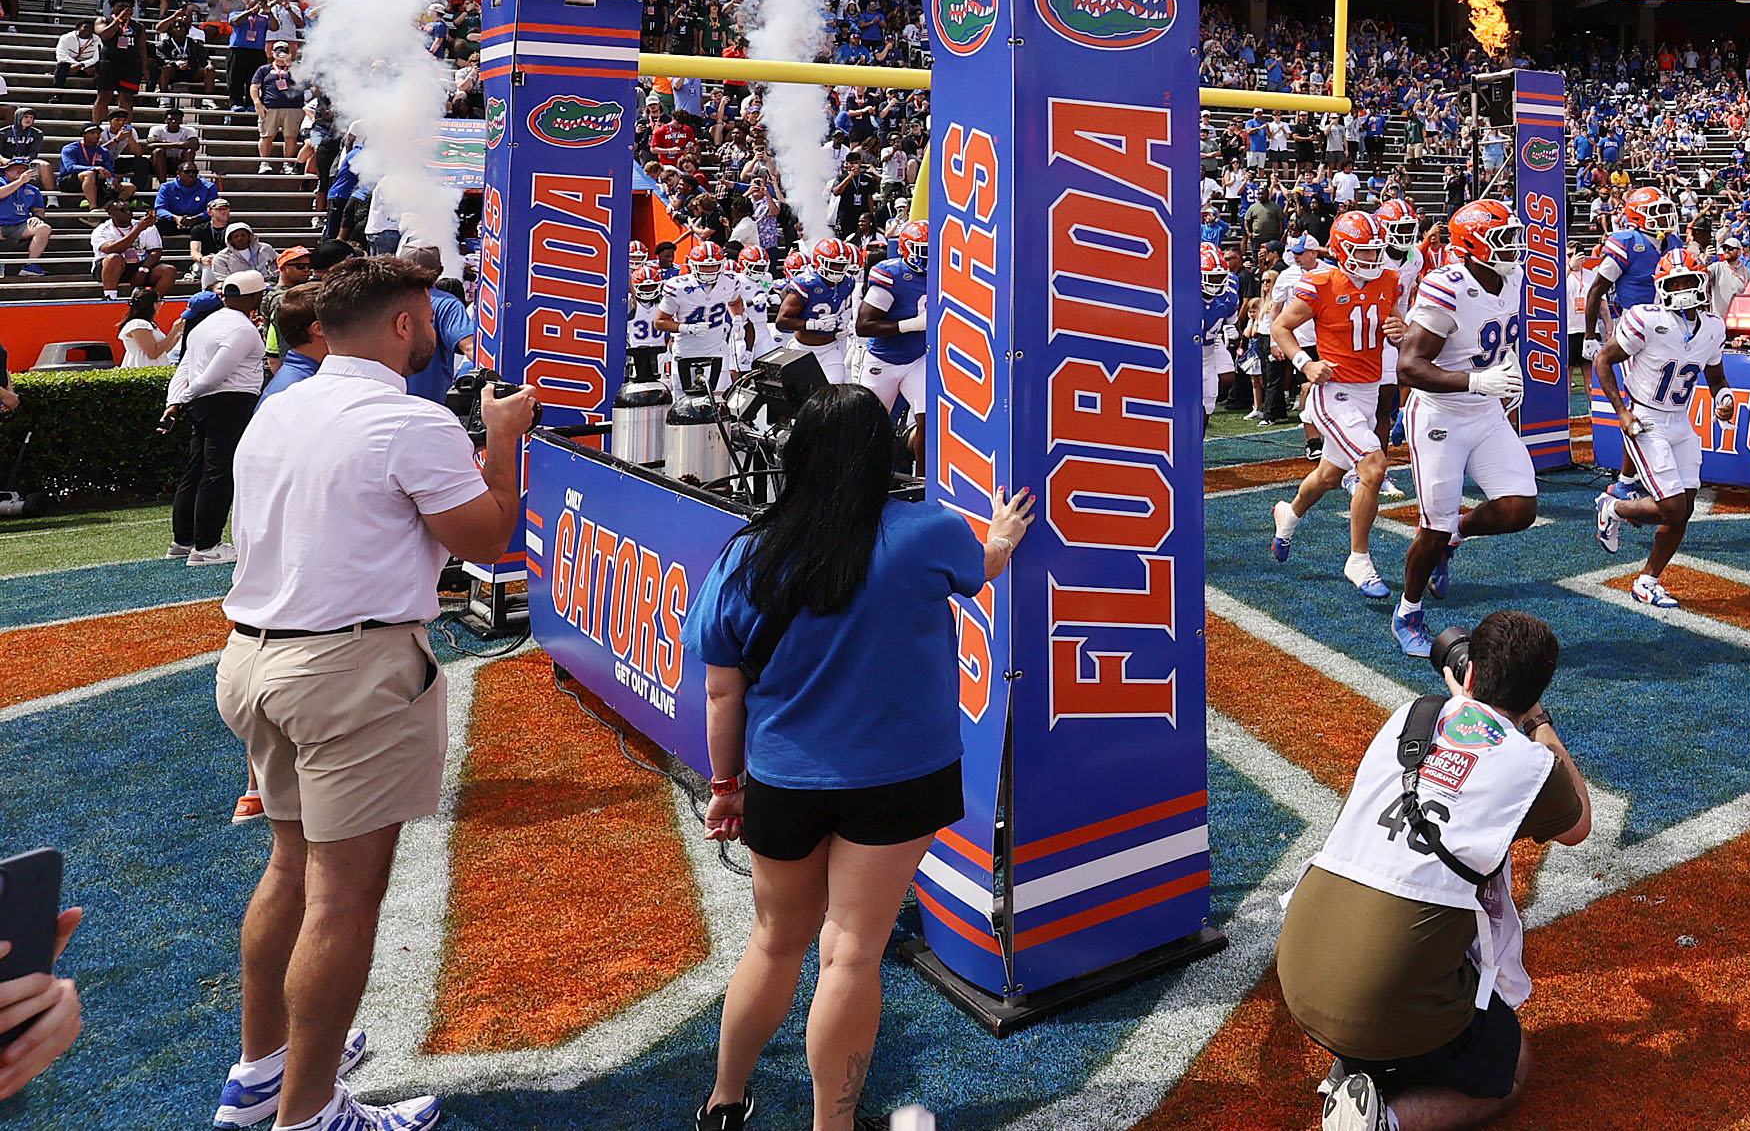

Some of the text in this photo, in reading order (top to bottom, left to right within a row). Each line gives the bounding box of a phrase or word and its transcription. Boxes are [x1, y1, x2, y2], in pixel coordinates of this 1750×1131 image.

[1524, 192, 1561, 385] GATORS
[520, 172, 613, 497] ORIDA
[684, 302, 725, 329] 42
[1349, 303, 1379, 352] 11
[1652, 359, 1700, 406] 13
[1046, 96, 1177, 731] FLORIDA
[565, 487, 583, 512] ONLY
[552, 508, 689, 694] GATORS
[615, 660, 676, 719] GET OUT ALIVE
[1423, 755, 1465, 777] BUREAU
[1439, 750, 1469, 768] FARM
